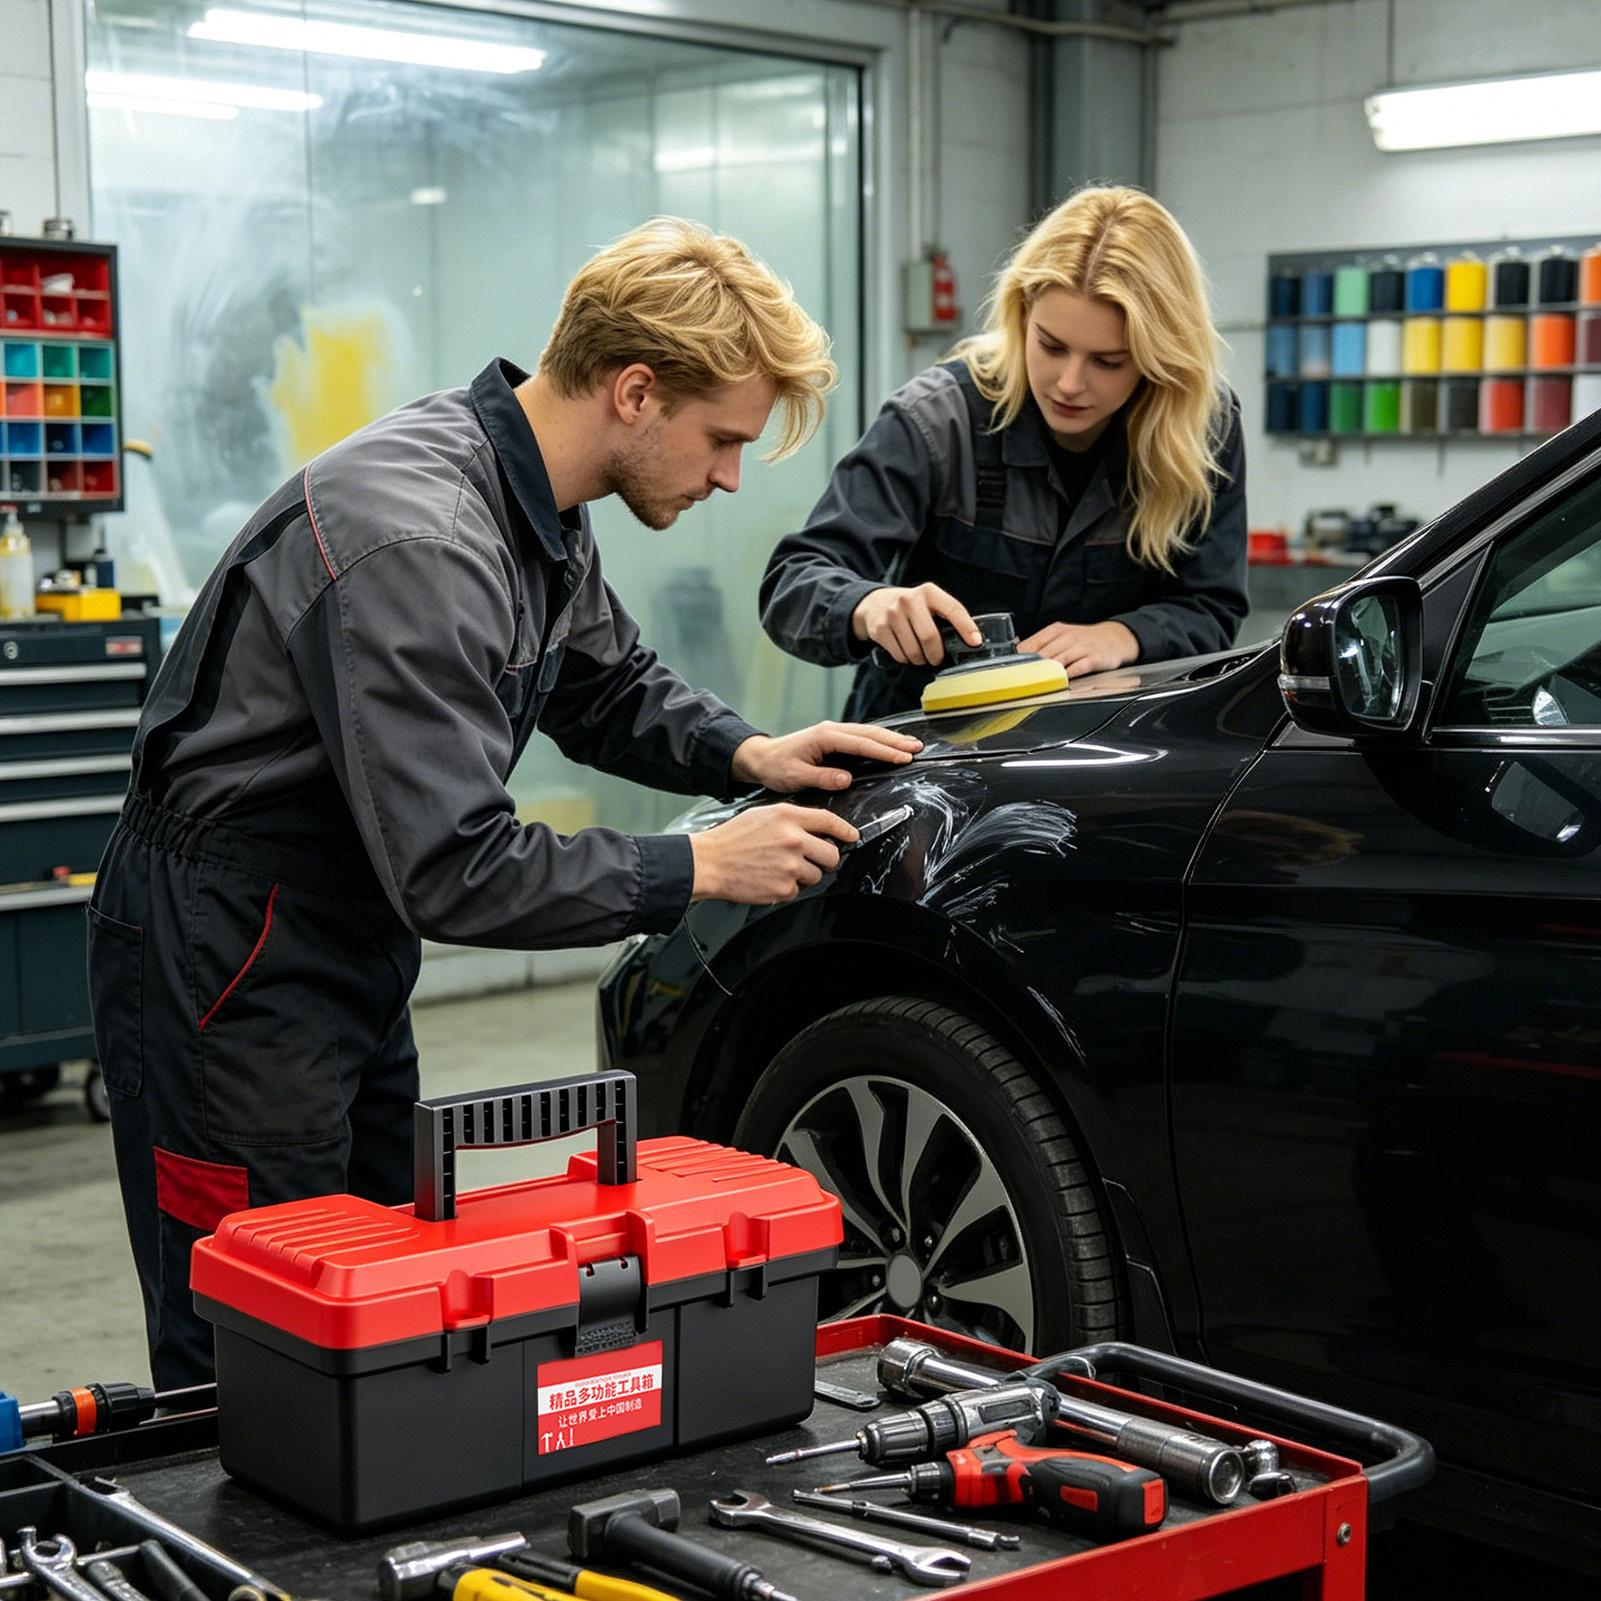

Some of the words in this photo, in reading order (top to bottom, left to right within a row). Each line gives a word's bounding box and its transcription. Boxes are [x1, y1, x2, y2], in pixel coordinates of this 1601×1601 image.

[549, 1373, 654, 1410] 精品多功能工具箱
[558, 1398, 643, 1428] 让世界爱上中国制造
